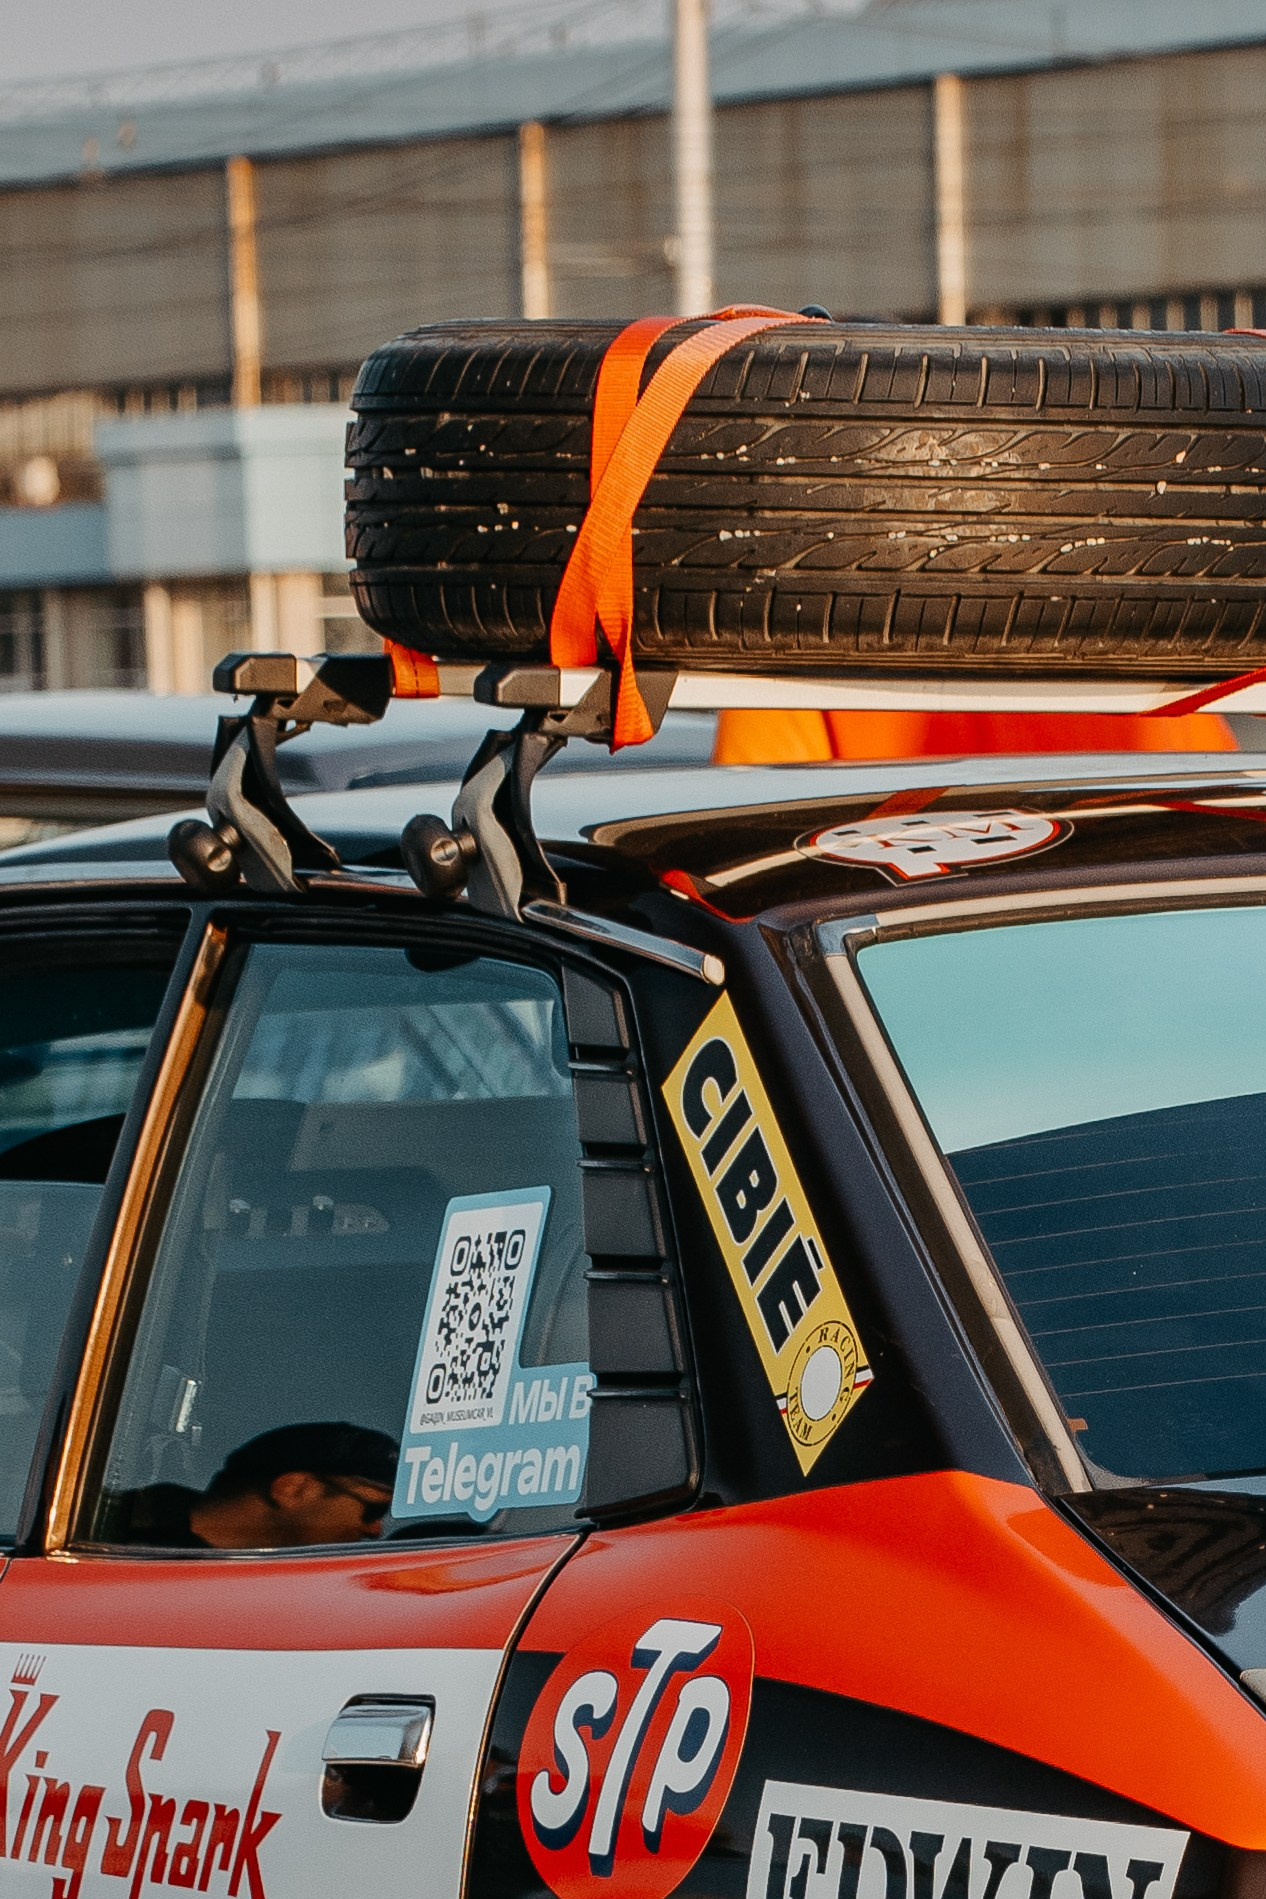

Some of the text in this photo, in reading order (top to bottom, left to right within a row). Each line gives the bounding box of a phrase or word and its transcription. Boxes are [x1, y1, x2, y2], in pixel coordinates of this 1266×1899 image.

[817, 1322, 858, 1406] RACING
[788, 1392, 813, 1442] TEAM
[404, 1442, 581, 1510] Telegram
[530, 1618, 730, 1876] STP
